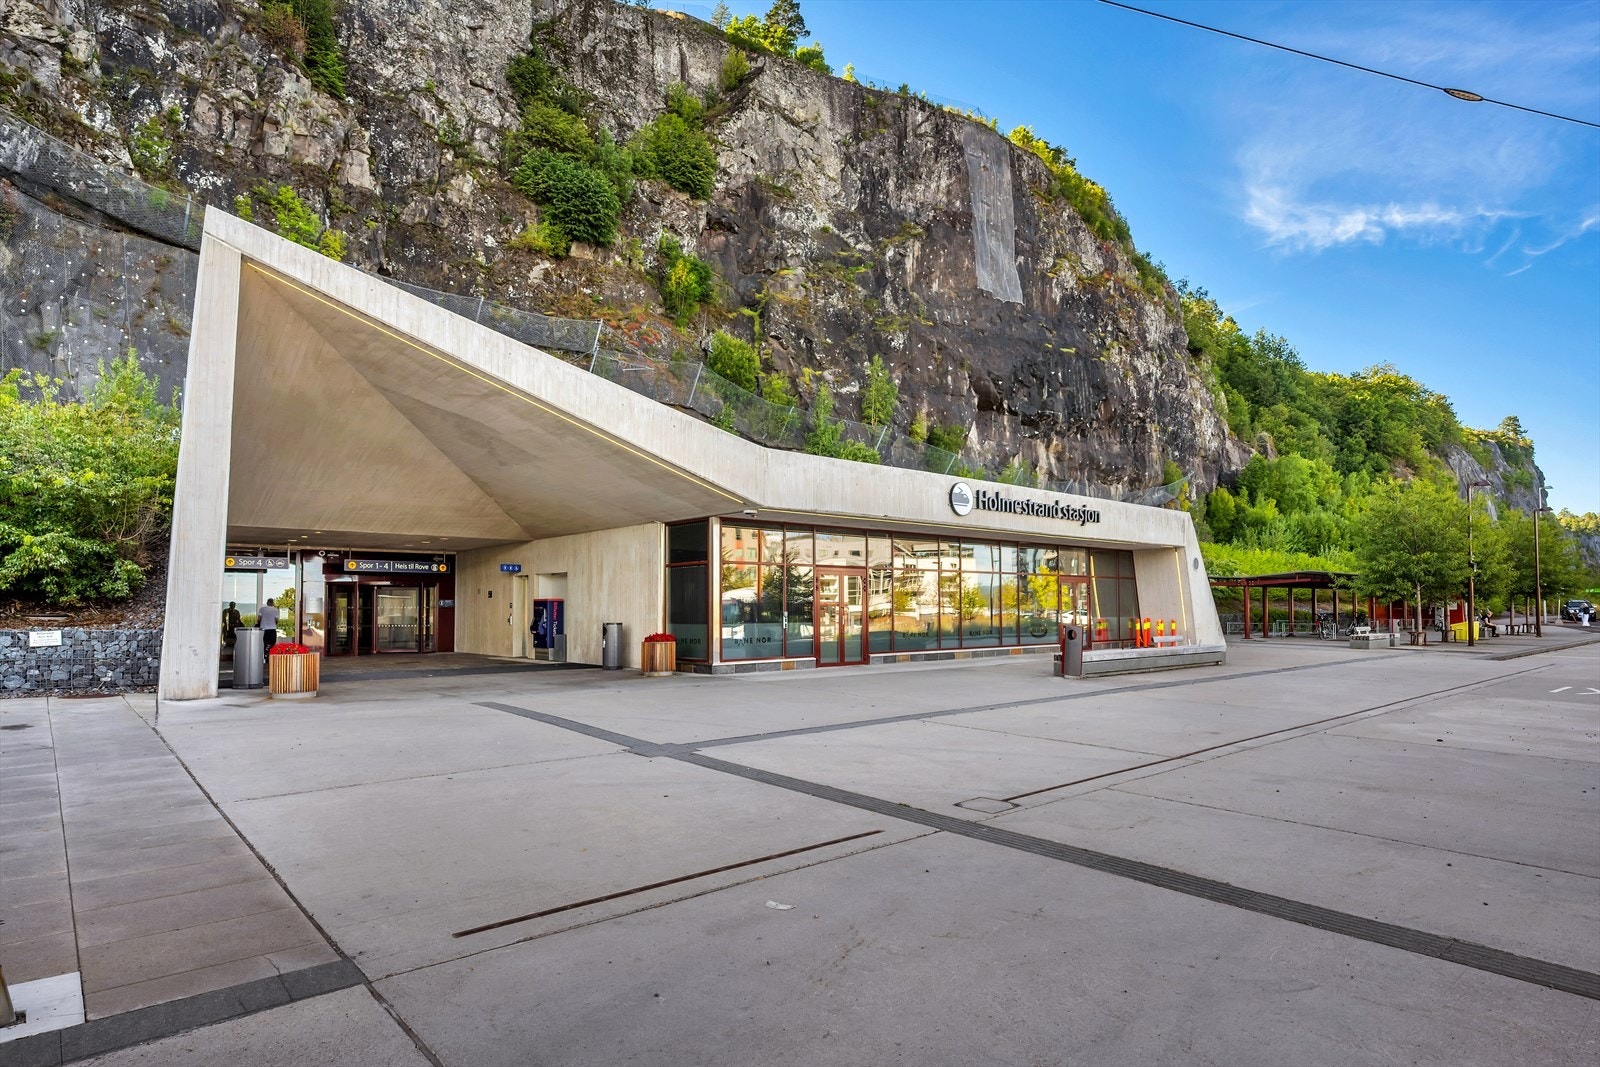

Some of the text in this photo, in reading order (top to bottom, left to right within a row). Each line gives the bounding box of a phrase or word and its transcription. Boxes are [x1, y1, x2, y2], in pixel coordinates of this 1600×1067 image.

[976, 489, 1100, 526] Holmestrand stasjon
[238, 558, 262, 567] Spor 4
[359, 561, 374, 570] Spor
[415, 563, 429, 571] Rove
[755, 636, 772, 644] NOR
